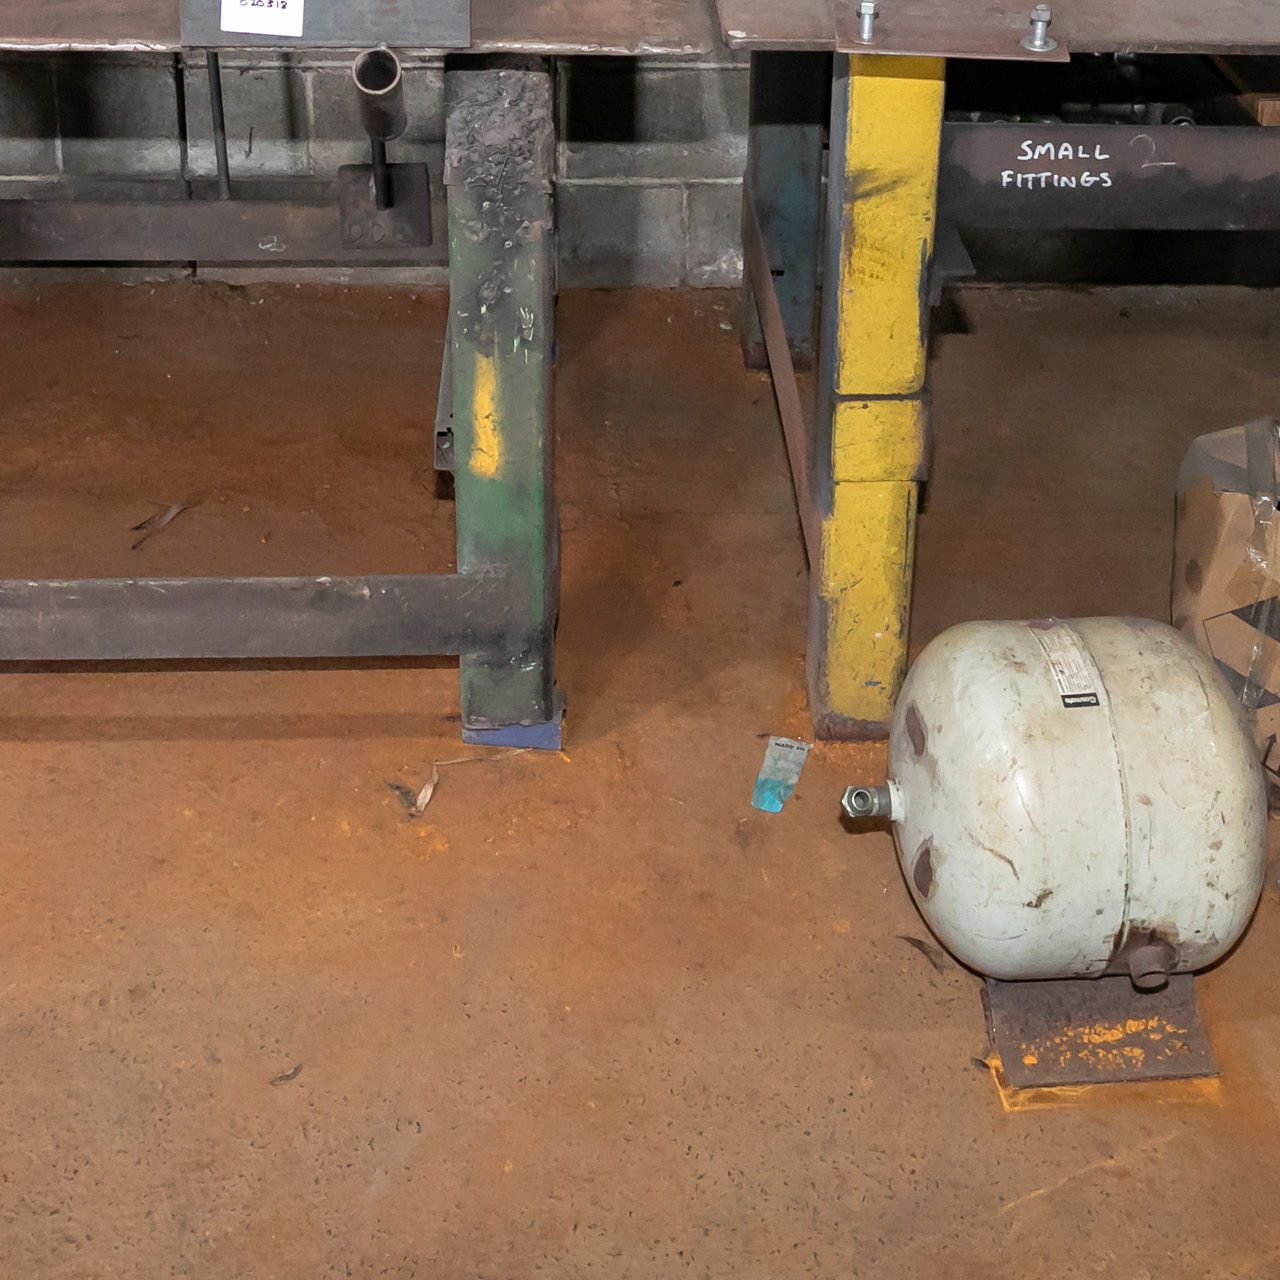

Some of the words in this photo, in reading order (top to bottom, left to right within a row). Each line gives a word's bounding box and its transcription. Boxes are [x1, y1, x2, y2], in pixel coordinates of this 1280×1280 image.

[1017, 139, 1110, 161] SMALL
[1000, 170, 1113, 190] FITTINGS
[774, 742, 794, 750] MADE
